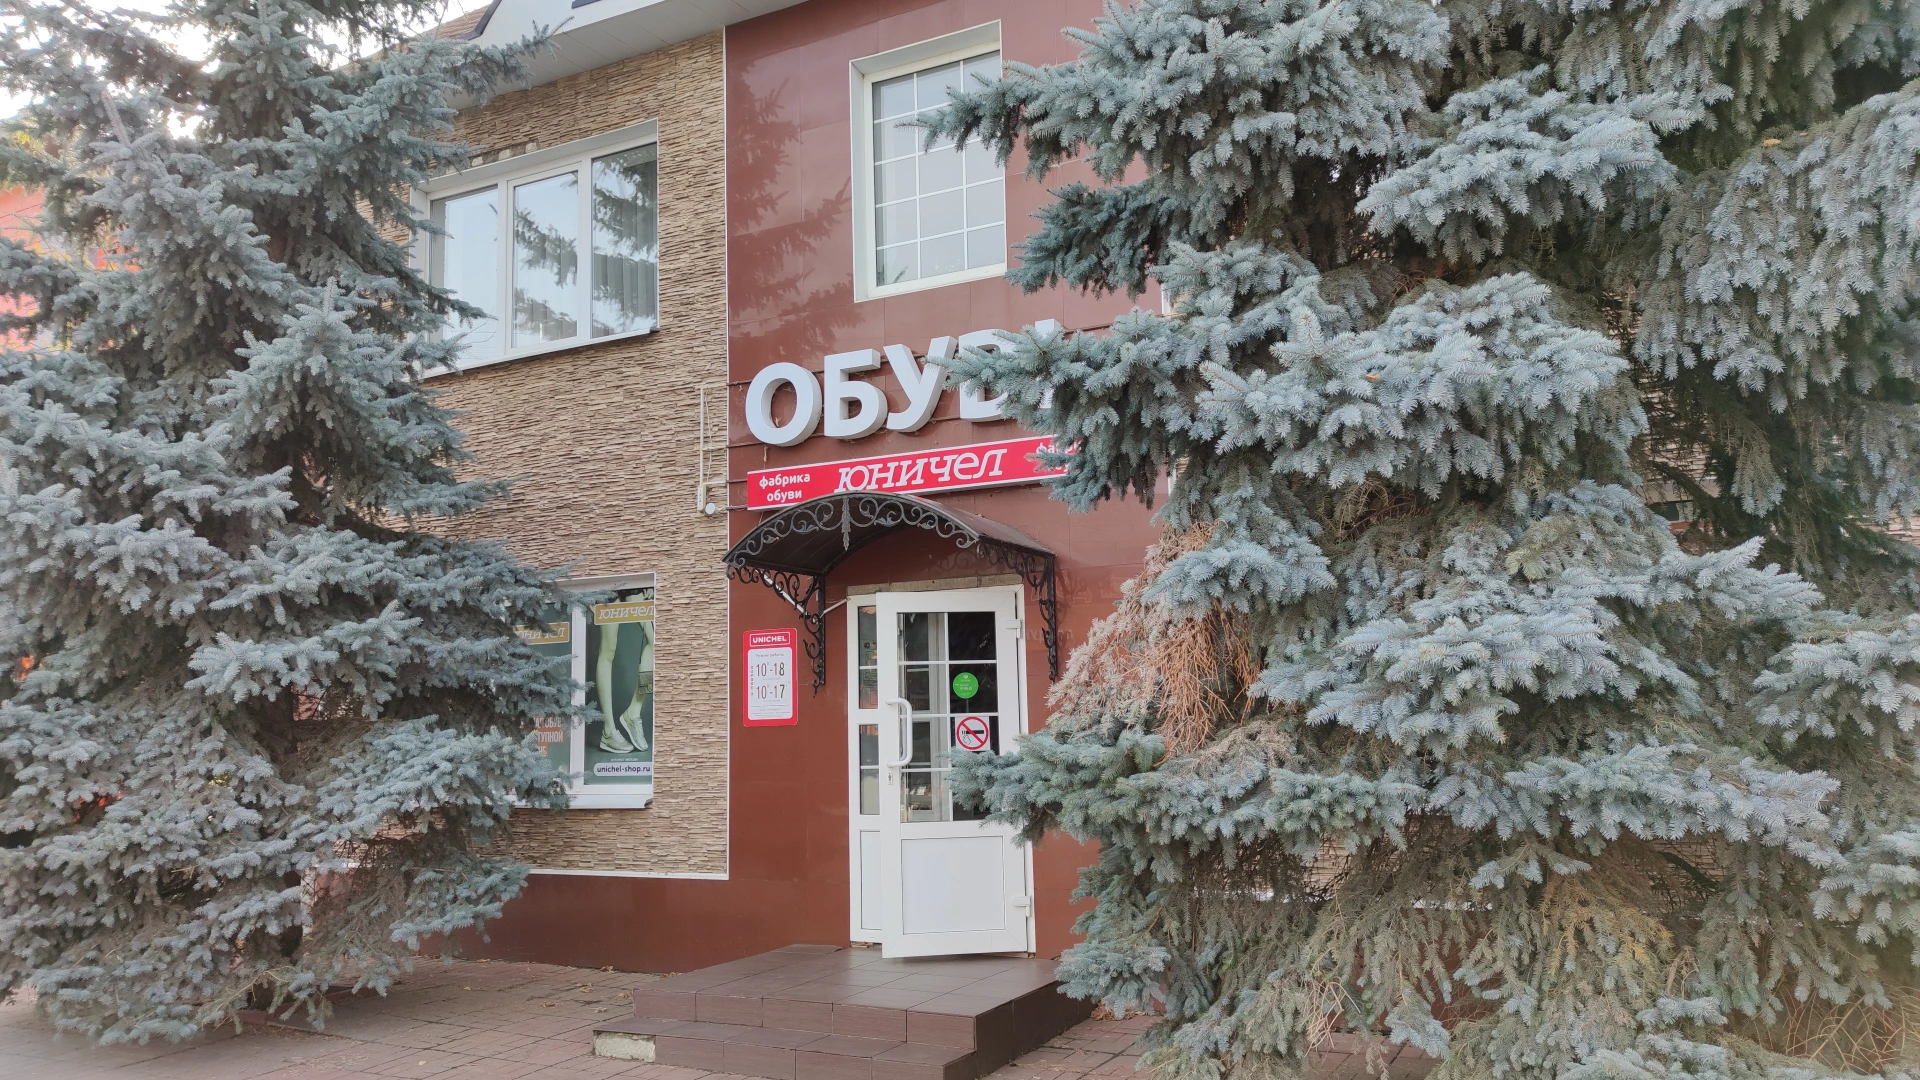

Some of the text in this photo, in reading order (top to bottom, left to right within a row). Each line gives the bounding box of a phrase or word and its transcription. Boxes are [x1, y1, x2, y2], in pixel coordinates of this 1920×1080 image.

[759, 472, 811, 489] фабрика
[766, 490, 802, 503] обуви
[752, 635, 787, 643] UNICHEL
[597, 765, 650, 774] unichel-shop.ru
